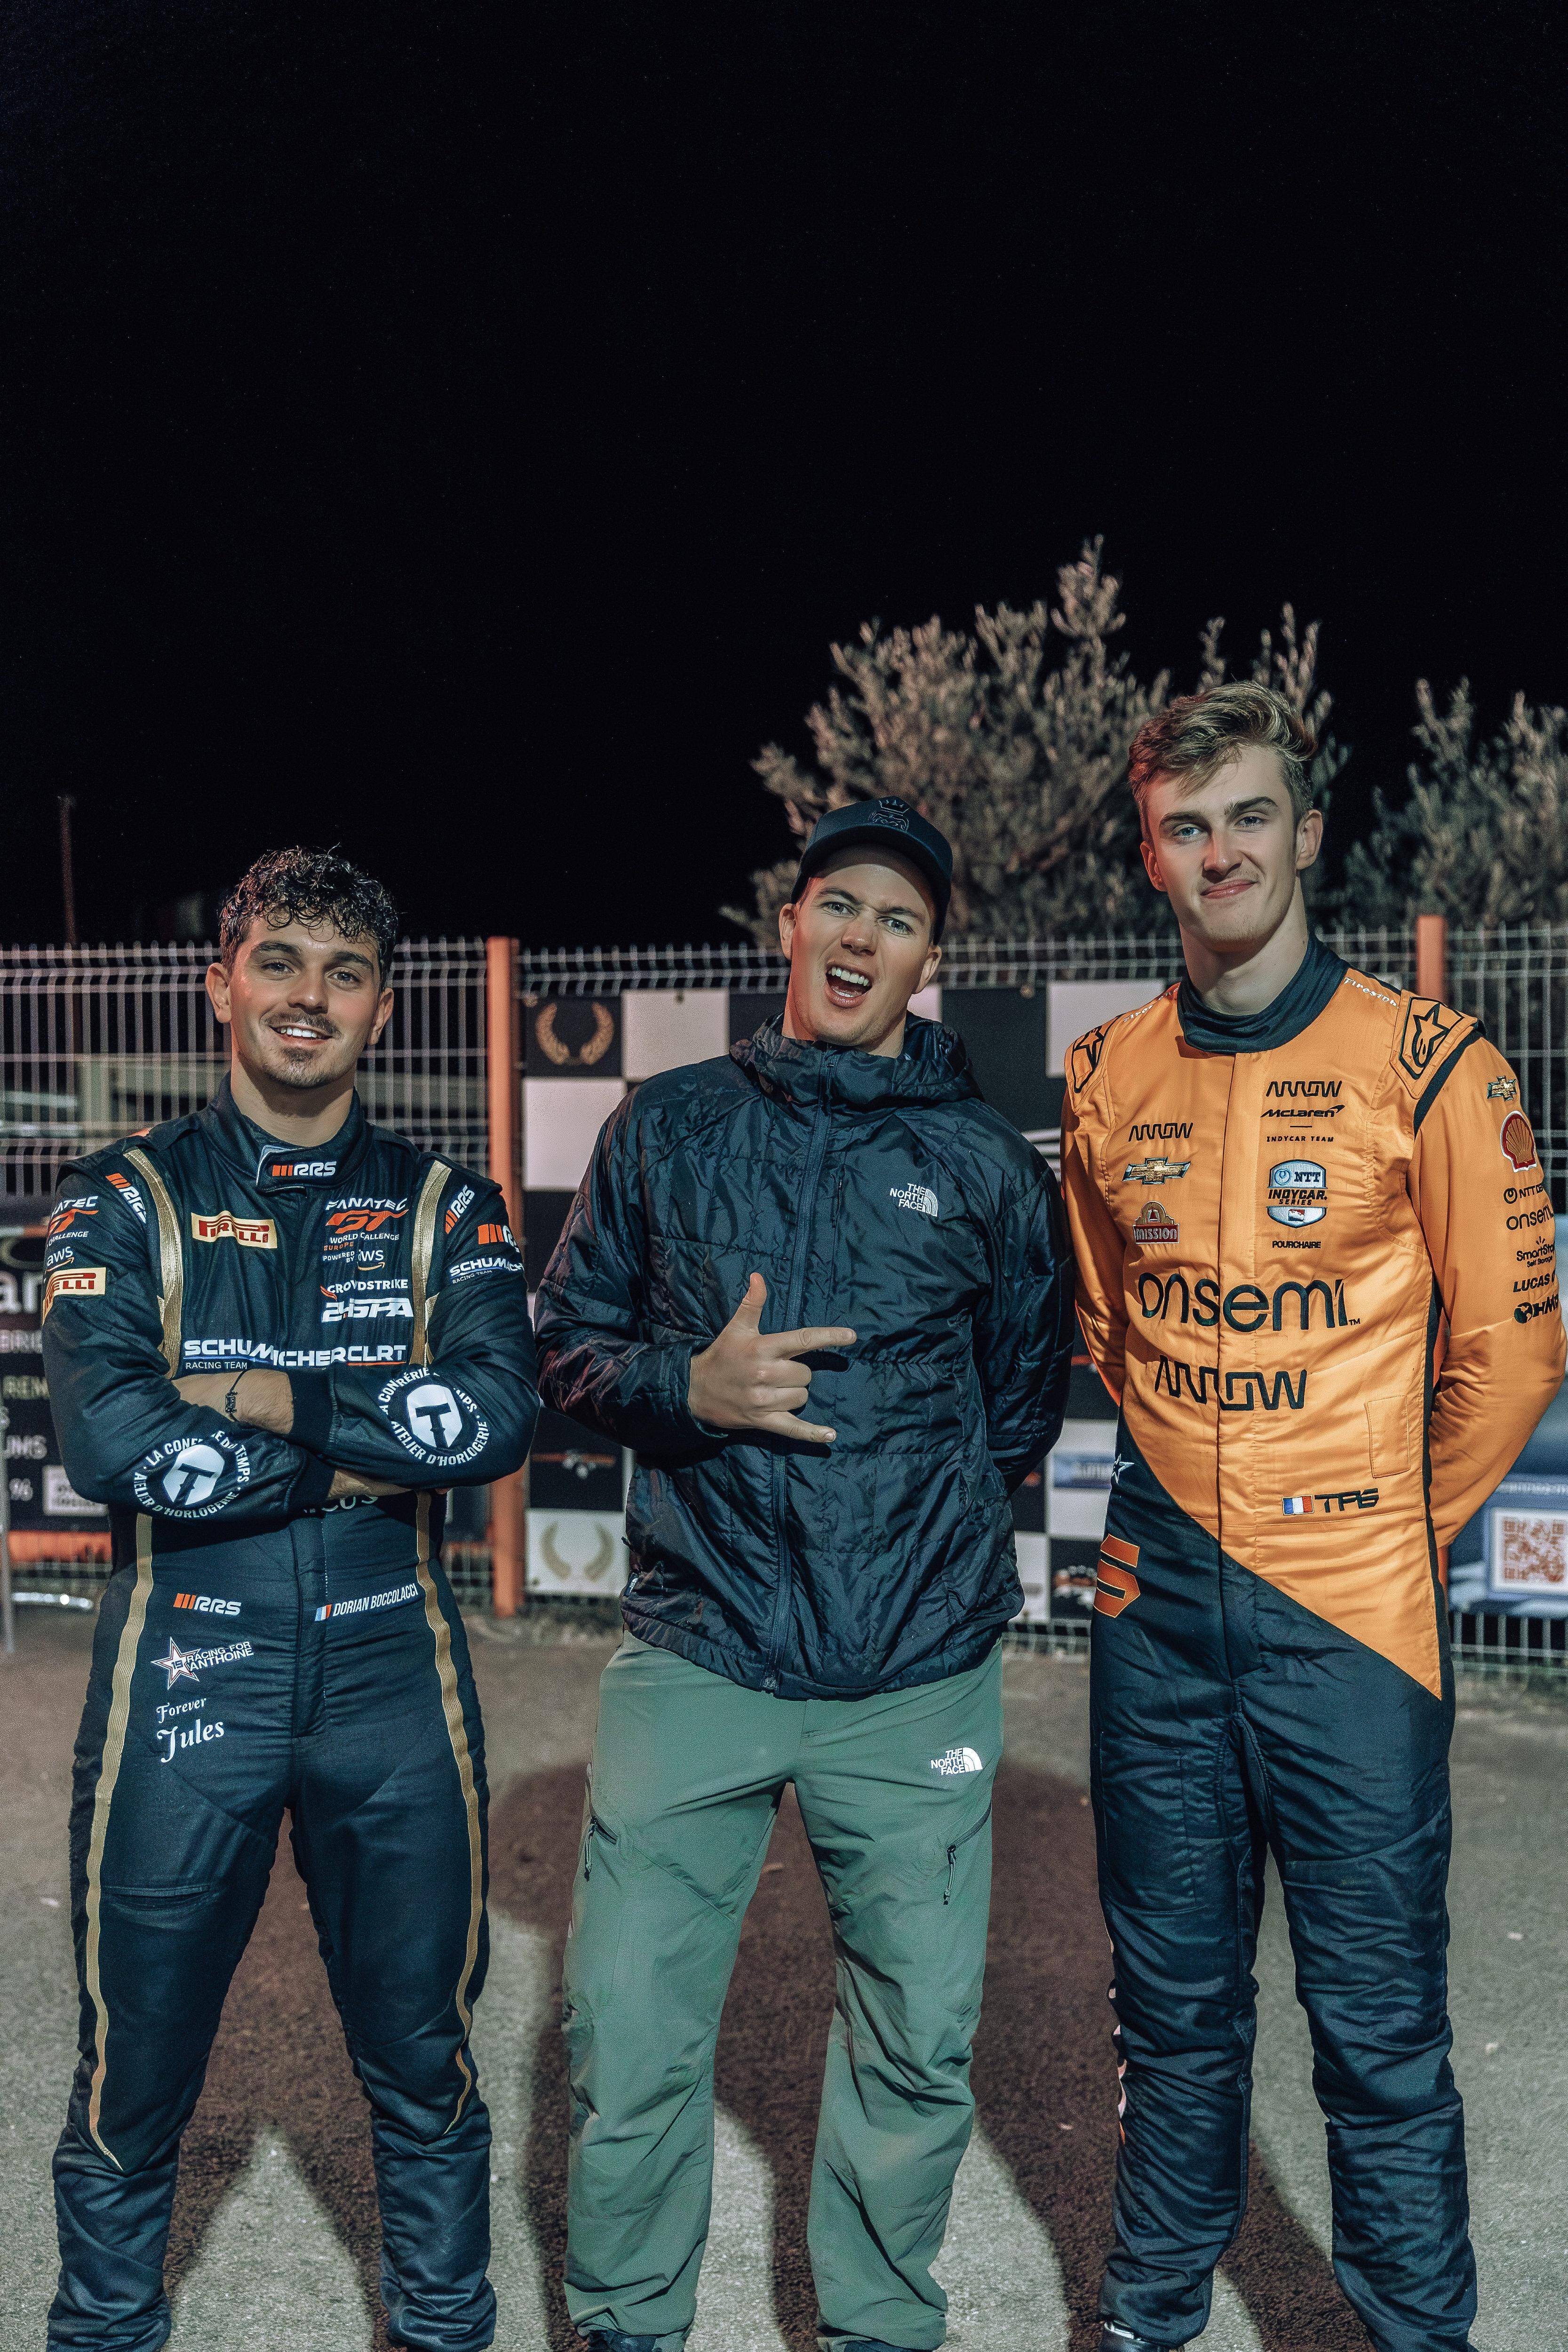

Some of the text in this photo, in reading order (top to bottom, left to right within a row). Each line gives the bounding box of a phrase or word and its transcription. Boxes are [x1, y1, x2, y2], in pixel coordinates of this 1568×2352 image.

[1344, 977, 1399, 1009] Fireston
[1266, 1081, 1343, 1097] ARROW
[1260, 1109, 1335, 1118] McLaren
[1128, 1122, 1194, 1142] ARROW
[294, 1161, 337, 1176] RRS
[1294, 1172, 1321, 1182] NTT
[890, 1188, 924, 1204] NORTH
[907, 1183, 926, 1195] THE
[326, 1198, 407, 1211] FANATEC
[450, 1184, 475, 1218] RRS
[899, 1199, 923, 1212] FACE
[1506, 1204, 1554, 1231] onsem
[324, 1242, 354, 1251] EUROPE
[330, 1232, 399, 1244] WORLD CALLENGE
[323, 1251, 355, 1261] POWERED
[453, 1273, 475, 1284] RACING
[1513, 1273, 1551, 1293] LUCAS
[1138, 1272, 1348, 1333] onsemi
[378, 1367, 430, 1402] CONRÉRIE
[1154, 1355, 1307, 1411] ARROW
[391, 1421, 426, 1460] ATELIER
[146, 1449, 164, 1466] LA
[194, 1596, 241, 1615] RRS
[333, 1583, 418, 1616] DORIAN BOCCOLACCI
[187, 1641, 251, 1663] RACING FOR
[189, 1647, 254, 1671] ANTHOINE
[156, 1698, 207, 1724] Forever
[157, 1718, 224, 1763] Jules
[945, 1748, 963, 1758] THE
[930, 1756, 963, 1769] NORTH
[941, 1764, 965, 1776] FACE
